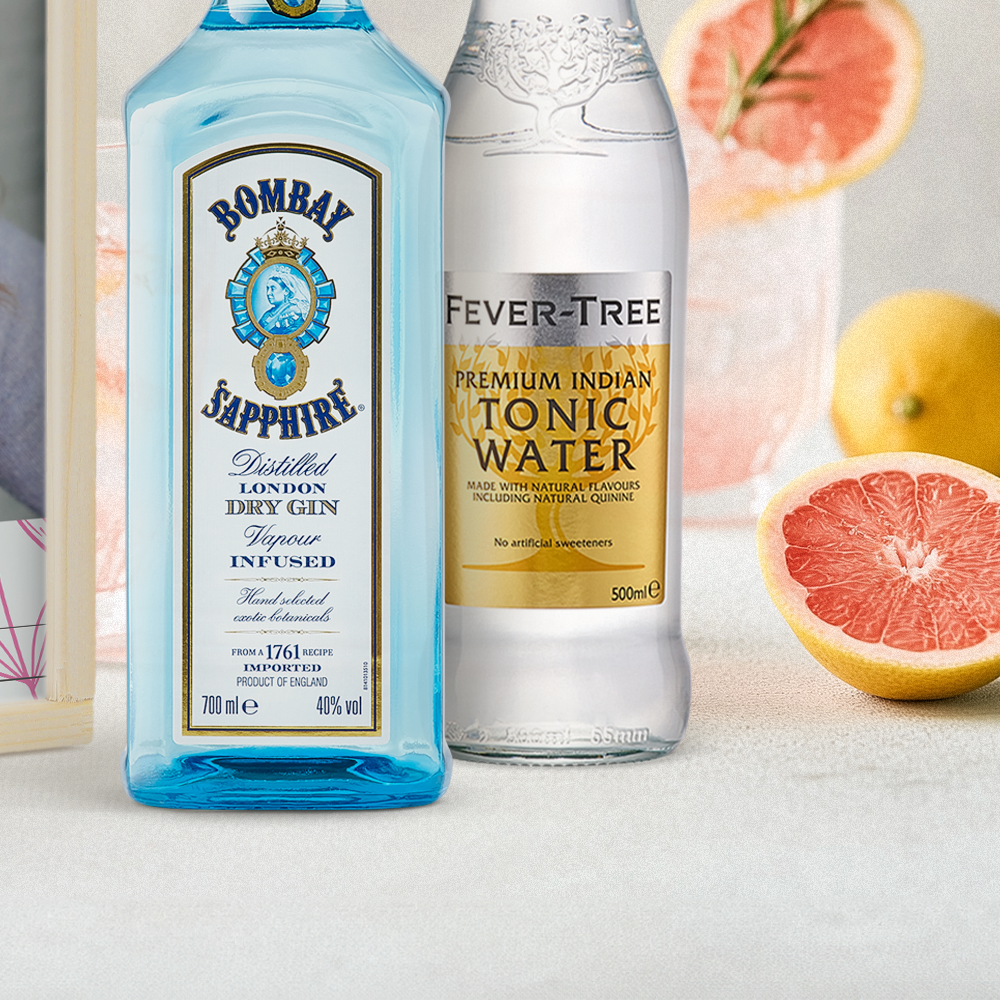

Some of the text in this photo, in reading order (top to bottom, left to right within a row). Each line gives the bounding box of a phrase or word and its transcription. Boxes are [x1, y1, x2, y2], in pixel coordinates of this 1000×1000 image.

[207, 177, 356, 243] BOMBAY
[446, 295, 662, 327] FEVER-TREE
[455, 369, 652, 390] PREMIUM INDIAN
[200, 377, 356, 440] SAPPHIRE
[478, 396, 630, 433] TONIC
[227, 448, 338, 477] Distilled
[472, 438, 637, 473] WATER
[240, 482, 326, 495] LONDON
[466, 480, 641, 493] MADE WITH NATURAL FLAVOURS
[224, 499, 341, 516] DRY GIN
[472, 492, 635, 505] INCLUDING NATURAL QUININE
[243, 524, 322, 553] Vapour
[494, 536, 614, 548] No artificial sweeteners
[230, 555, 336, 569] INFUSED
[236, 587, 328, 606] Hand selected
[611, 585, 648, 602] 500ml
[233, 609, 333, 623] exotic botanicals
[231, 643, 334, 660] FROM A 1761 RECIPE
[243, 663, 322, 673] IMPORTED
[236, 676, 329, 688] PRODUCT OF ENGLAND
[201, 695, 222, 715] 700
[225, 695, 239, 715] ml
[316, 695, 363, 716] 40% vol
